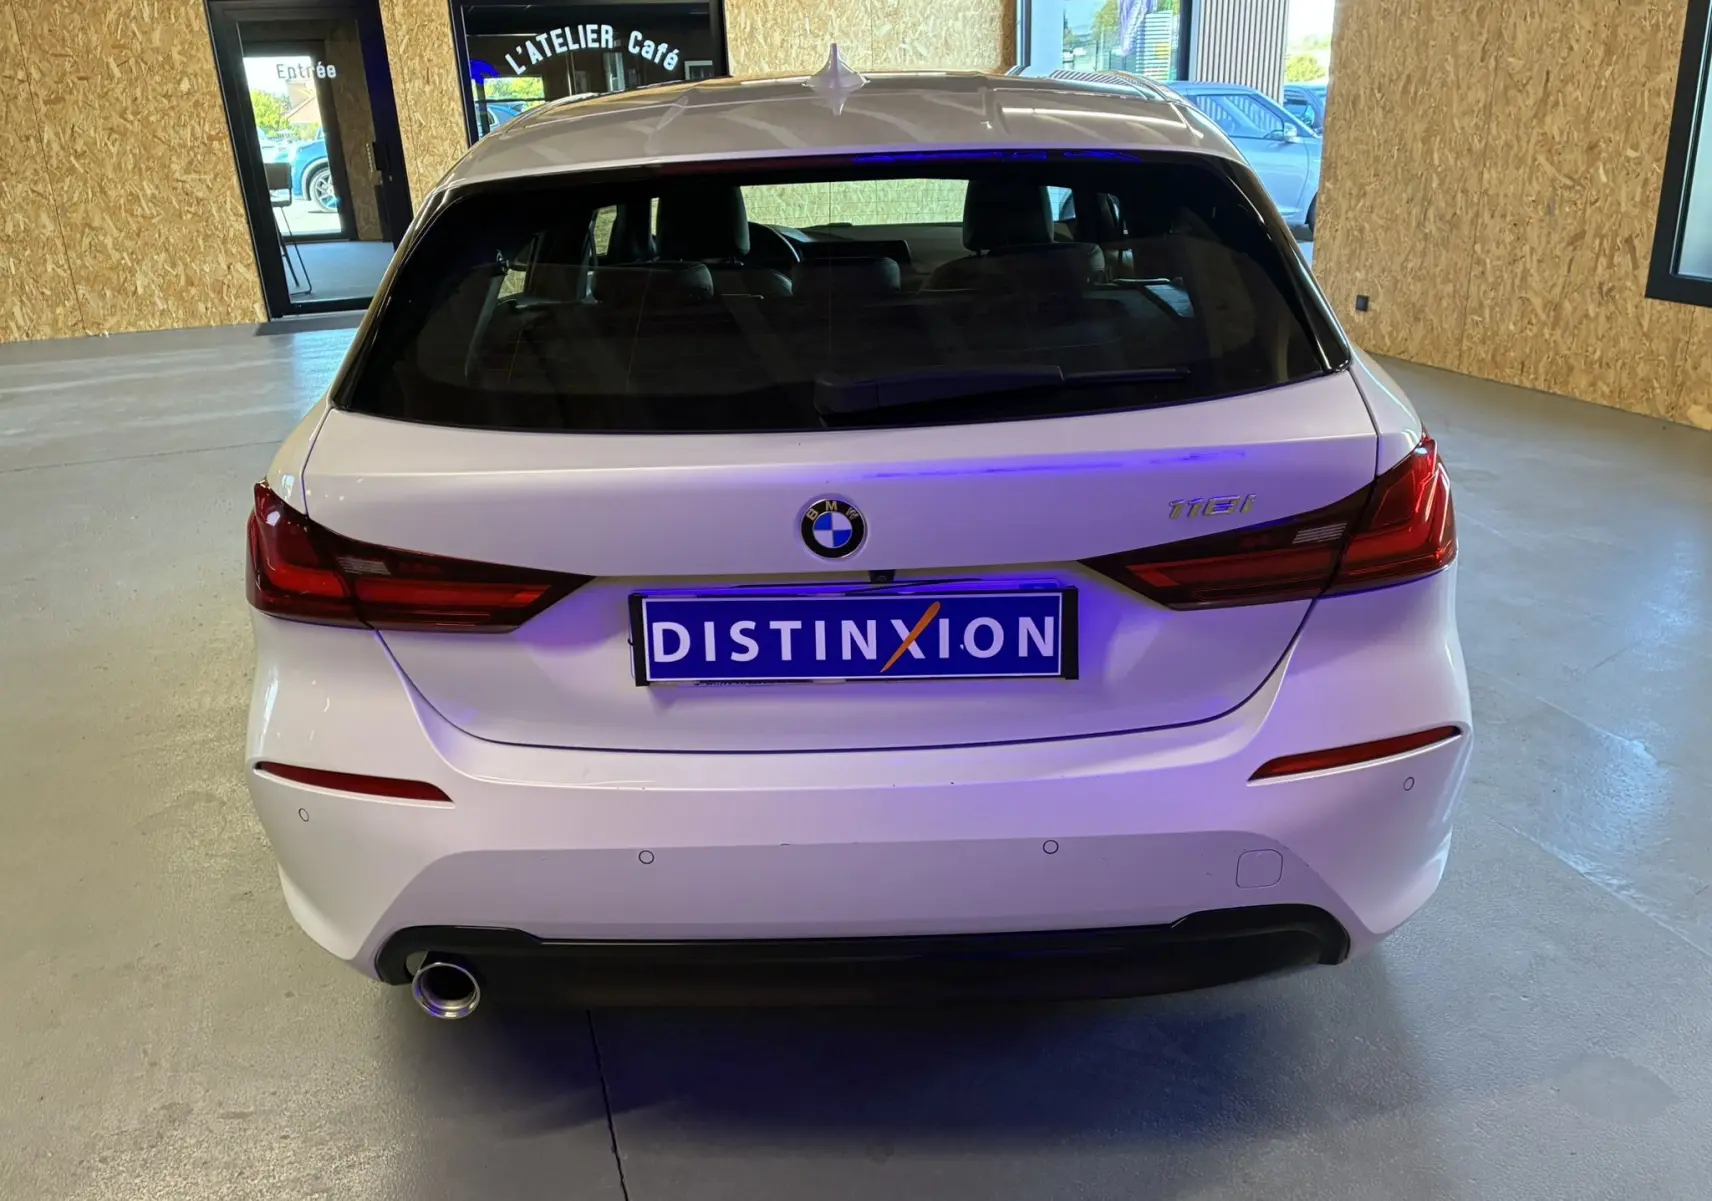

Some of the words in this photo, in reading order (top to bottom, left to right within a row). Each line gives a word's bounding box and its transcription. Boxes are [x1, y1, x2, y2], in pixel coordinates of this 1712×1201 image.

[505, 24, 613, 76] L'ATELIER
[627, 30, 680, 72] Café
[276, 61, 336, 79] Entrée
[806, 500, 860, 521] BMW
[1169, 493, 1256, 519] 118i
[652, 601, 1055, 673] DISTINXION
